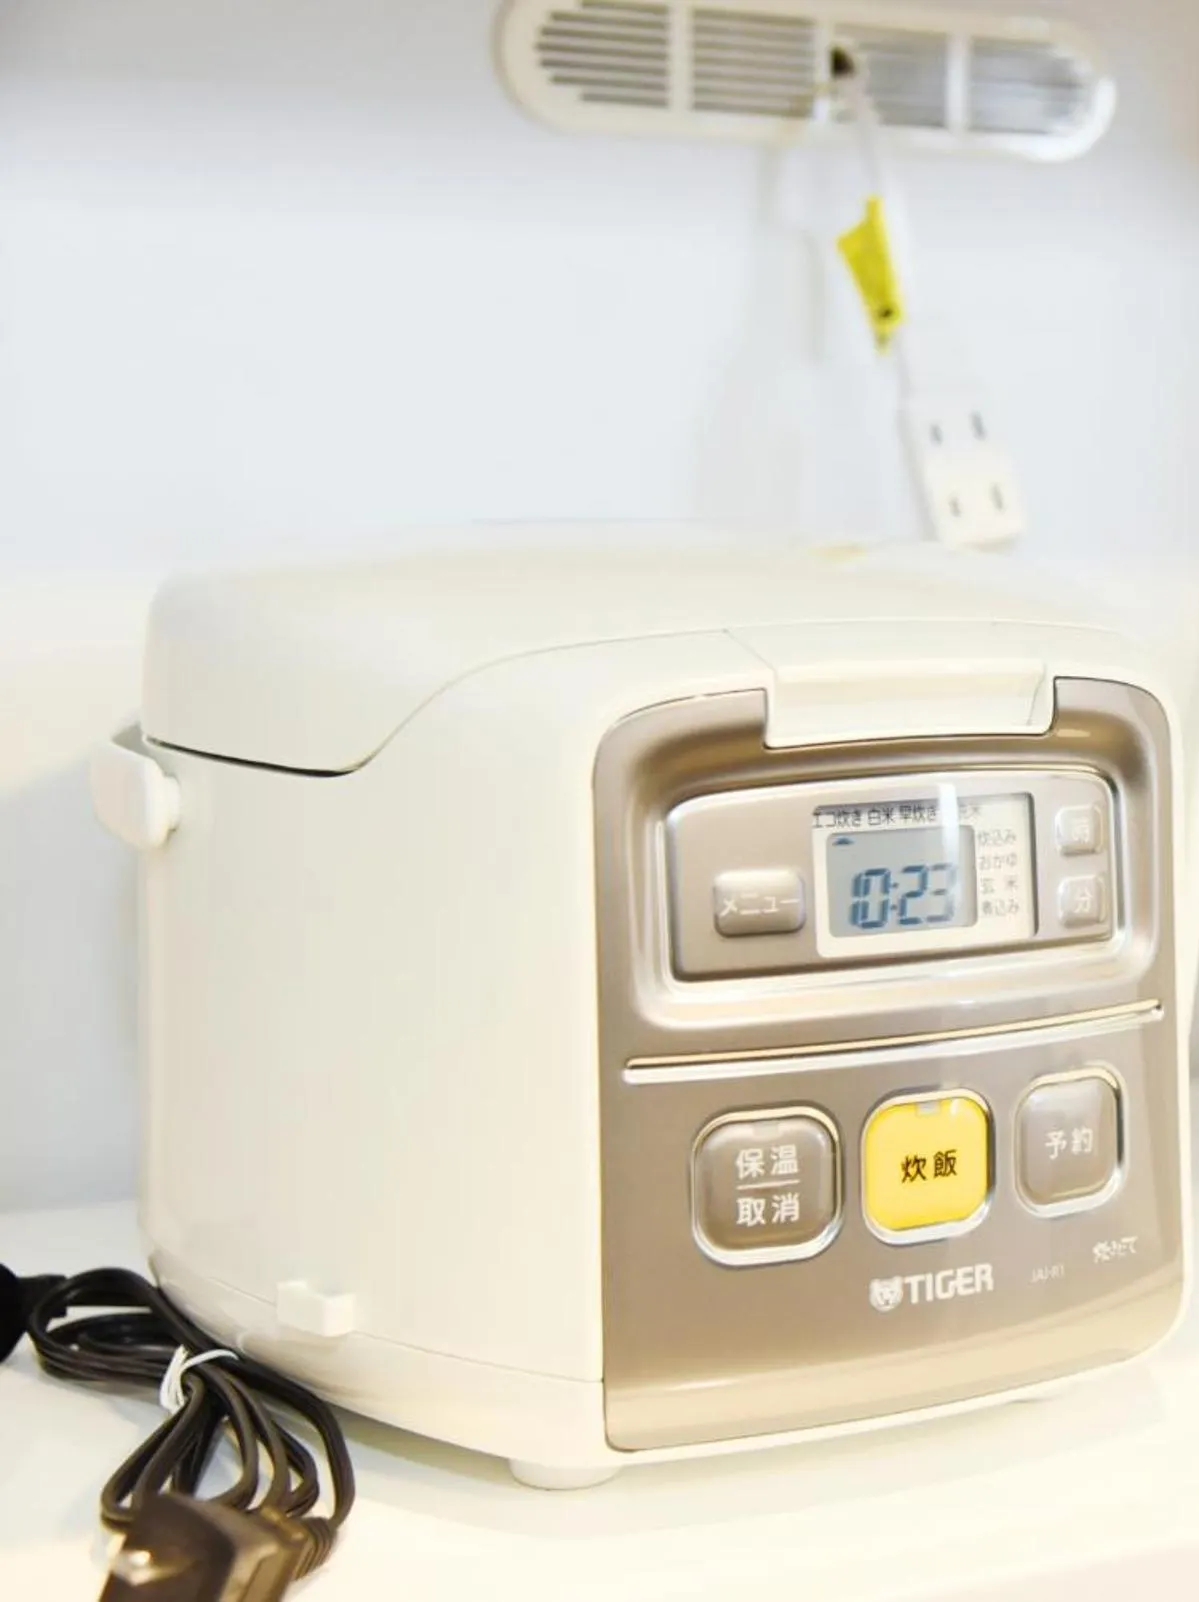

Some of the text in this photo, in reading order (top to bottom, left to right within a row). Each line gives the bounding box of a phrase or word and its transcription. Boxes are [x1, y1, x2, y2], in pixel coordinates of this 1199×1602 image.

[868, 806, 895, 826] 白米
[720, 891, 800, 917] メニュー
[849, 863, 955, 929] 10:23
[1073, 887, 1094, 913] 分
[1044, 1126, 1094, 1161] 予約
[736, 1144, 800, 1181] 保温
[901, 1149, 958, 1184] 炊飯
[736, 1193, 801, 1228] 取消
[904, 1263, 994, 1304] TIGER
